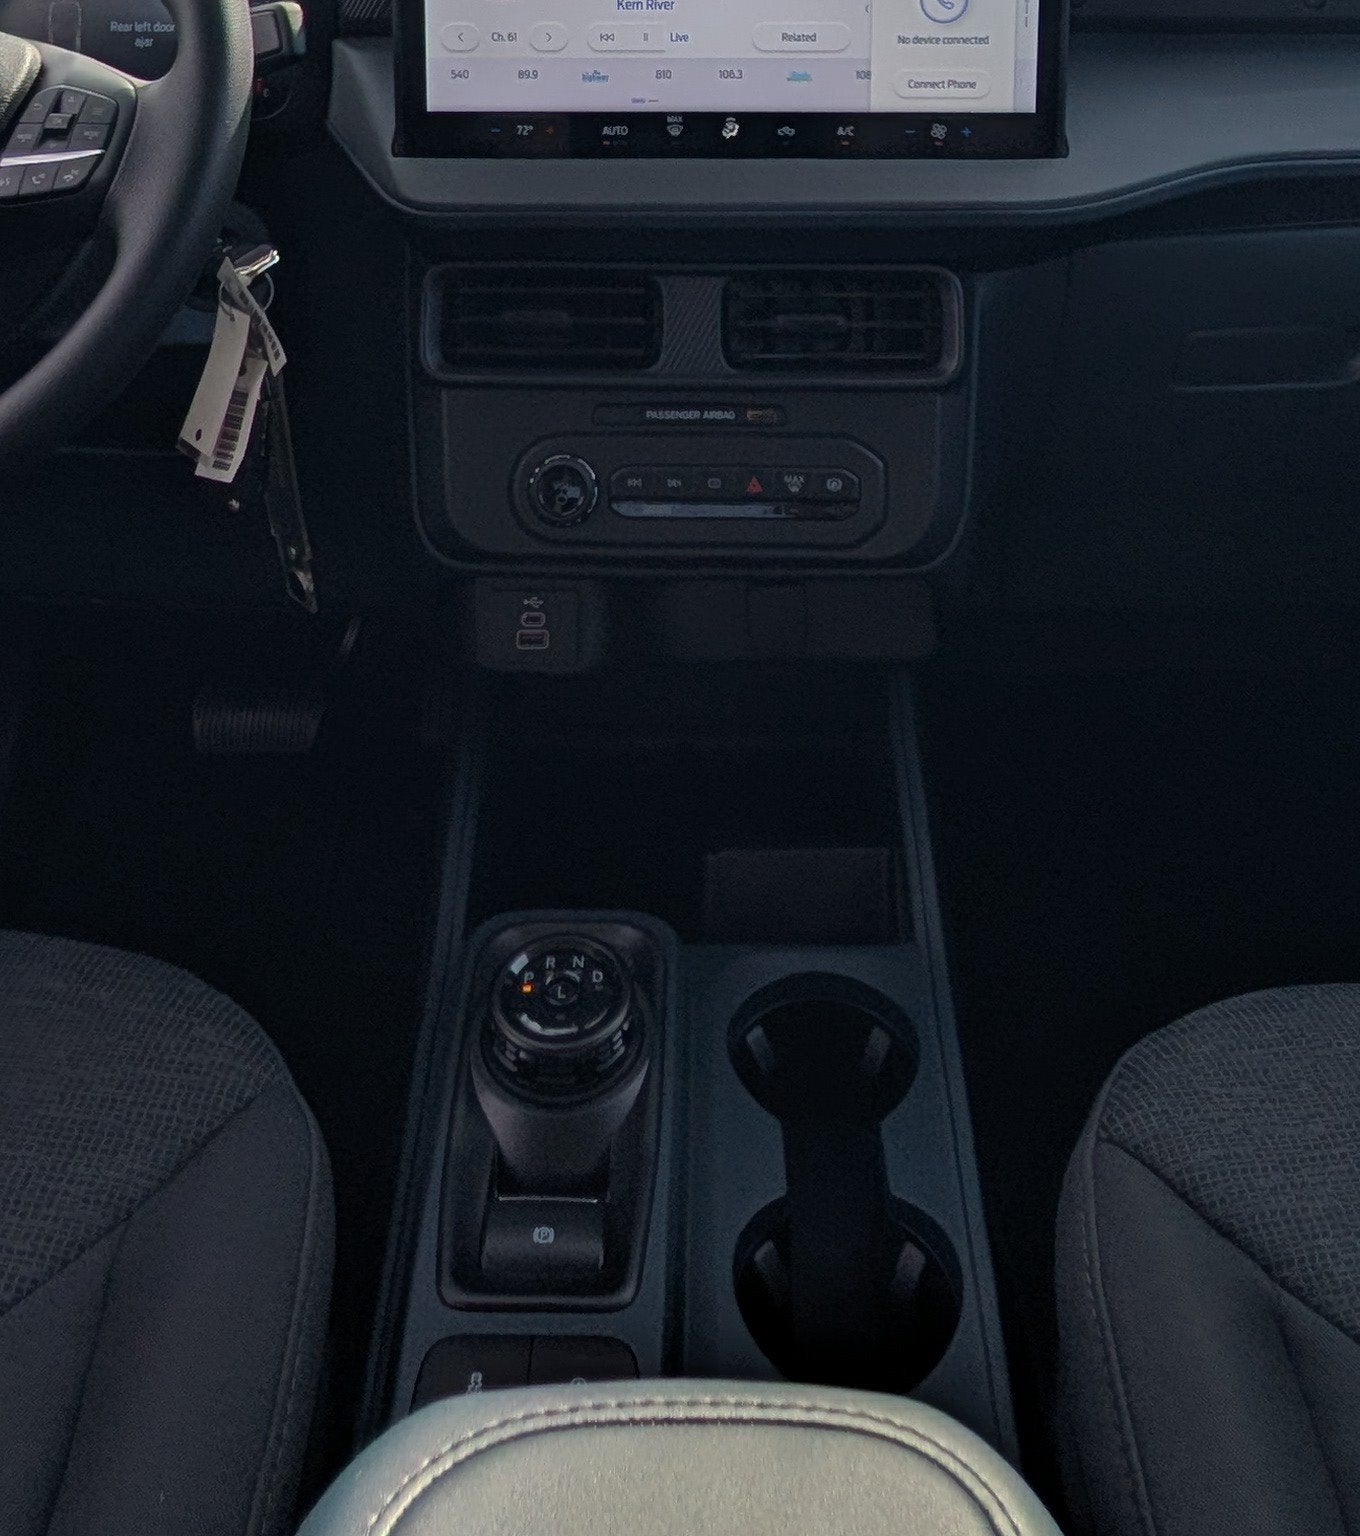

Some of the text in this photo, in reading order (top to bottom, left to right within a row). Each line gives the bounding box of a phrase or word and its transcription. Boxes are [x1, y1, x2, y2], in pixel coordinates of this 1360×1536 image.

[616, 0, 675, 11] Kern River
[110, 20, 176, 33] Rear left door
[135, 37, 153, 49] ajar
[507, 32, 518, 43] 61
[670, 32, 689, 43] Live
[781, 32, 817, 43] Related
[897, 35, 990, 46] No device connected
[450, 70, 470, 80] 540
[518, 70, 539, 80] 89.9
[908, 79, 977, 90] Connect Phone
[602, 124, 629, 137] AUTO
[836, 125, 855, 137] A/C
[645, 409, 700, 420] PASSENGER
[702, 409, 736, 420] AIRBAG
[546, 955, 556, 969] R
[572, 955, 585, 968] N
[523, 971, 535, 984] P
[592, 969, 604, 983] D
[557, 985, 567, 999] L
